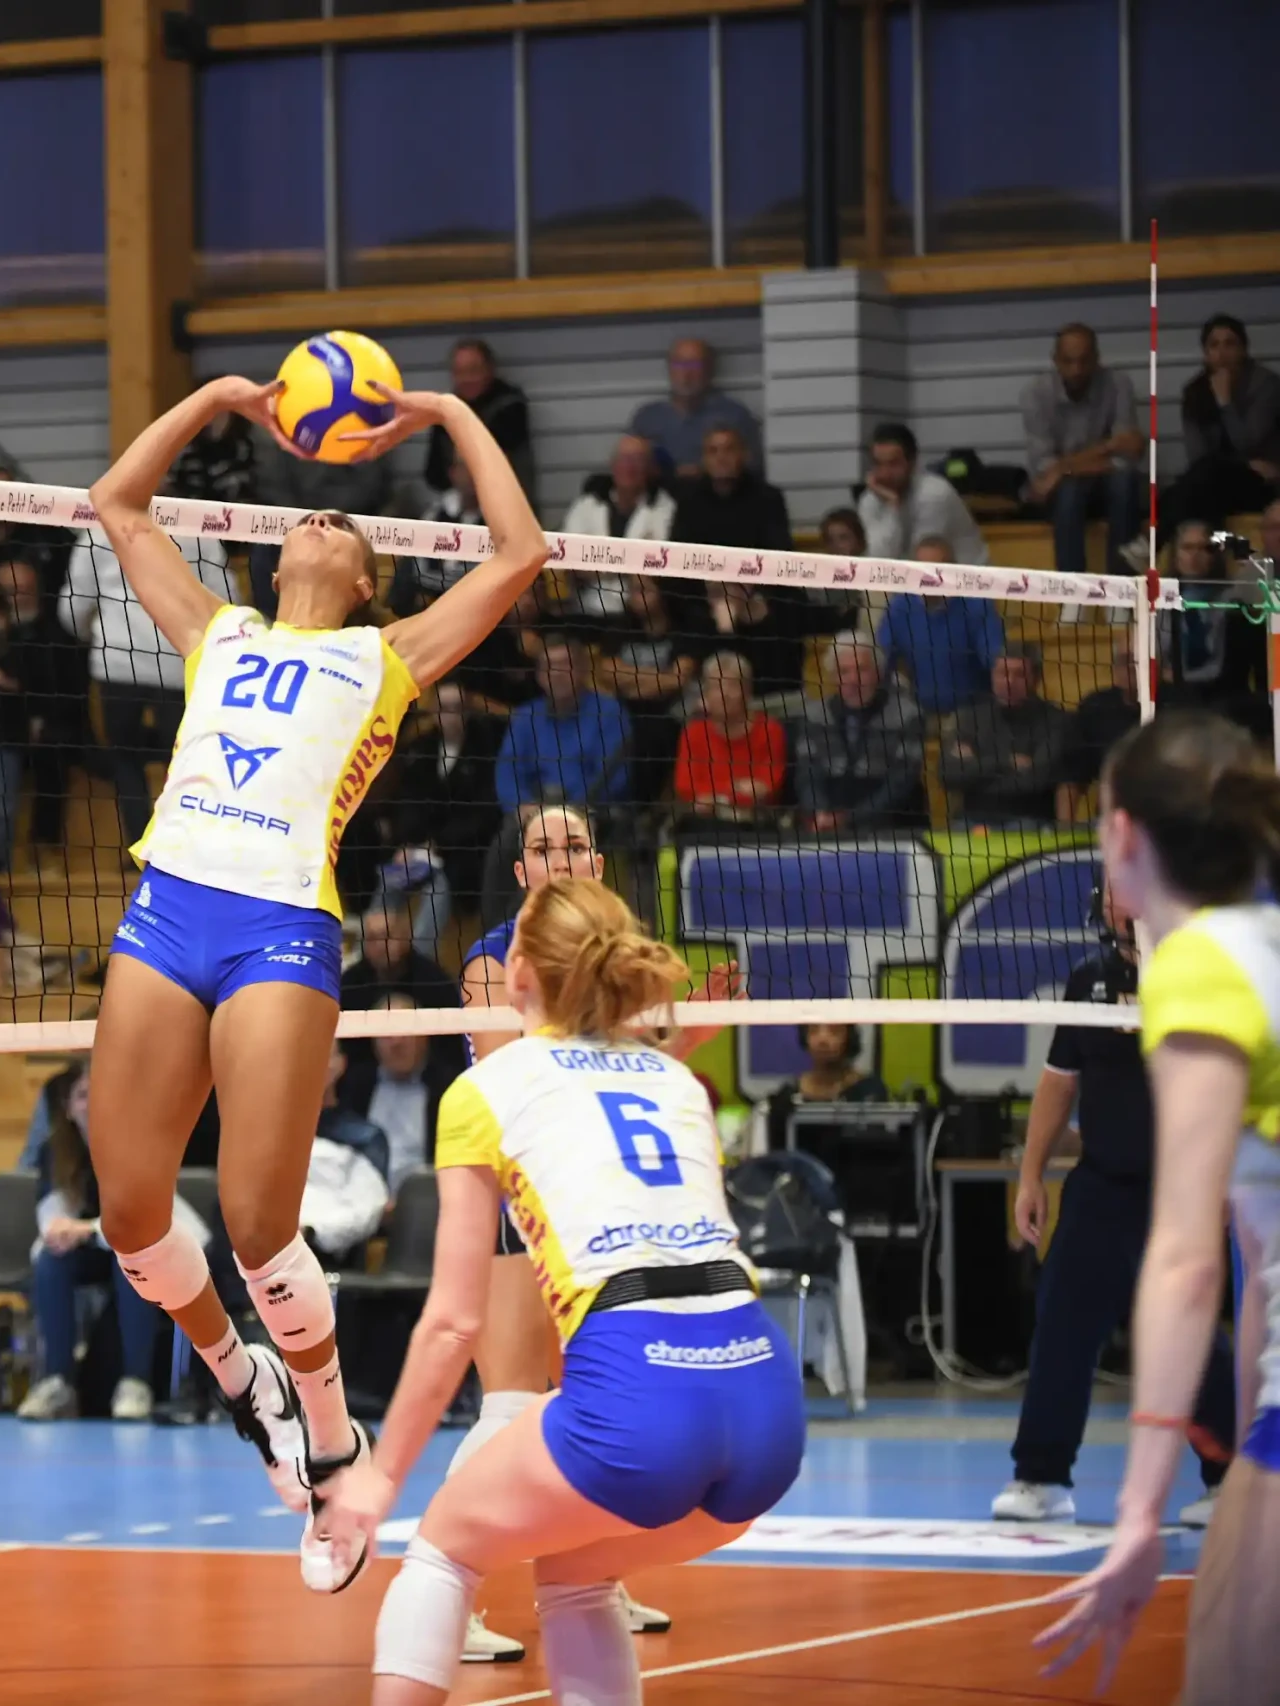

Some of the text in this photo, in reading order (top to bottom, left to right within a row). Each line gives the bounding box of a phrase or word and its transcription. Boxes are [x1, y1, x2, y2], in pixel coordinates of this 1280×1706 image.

[6, 492, 27, 514] Petit
[28, 495, 55, 515] Fournil
[221, 653, 310, 715] 20
[180, 795, 291, 836] CUPRA
[549, 1049, 666, 1072] GRIGGS
[596, 1092, 684, 1187] 6
[644, 1336, 772, 1362] chronodrive
